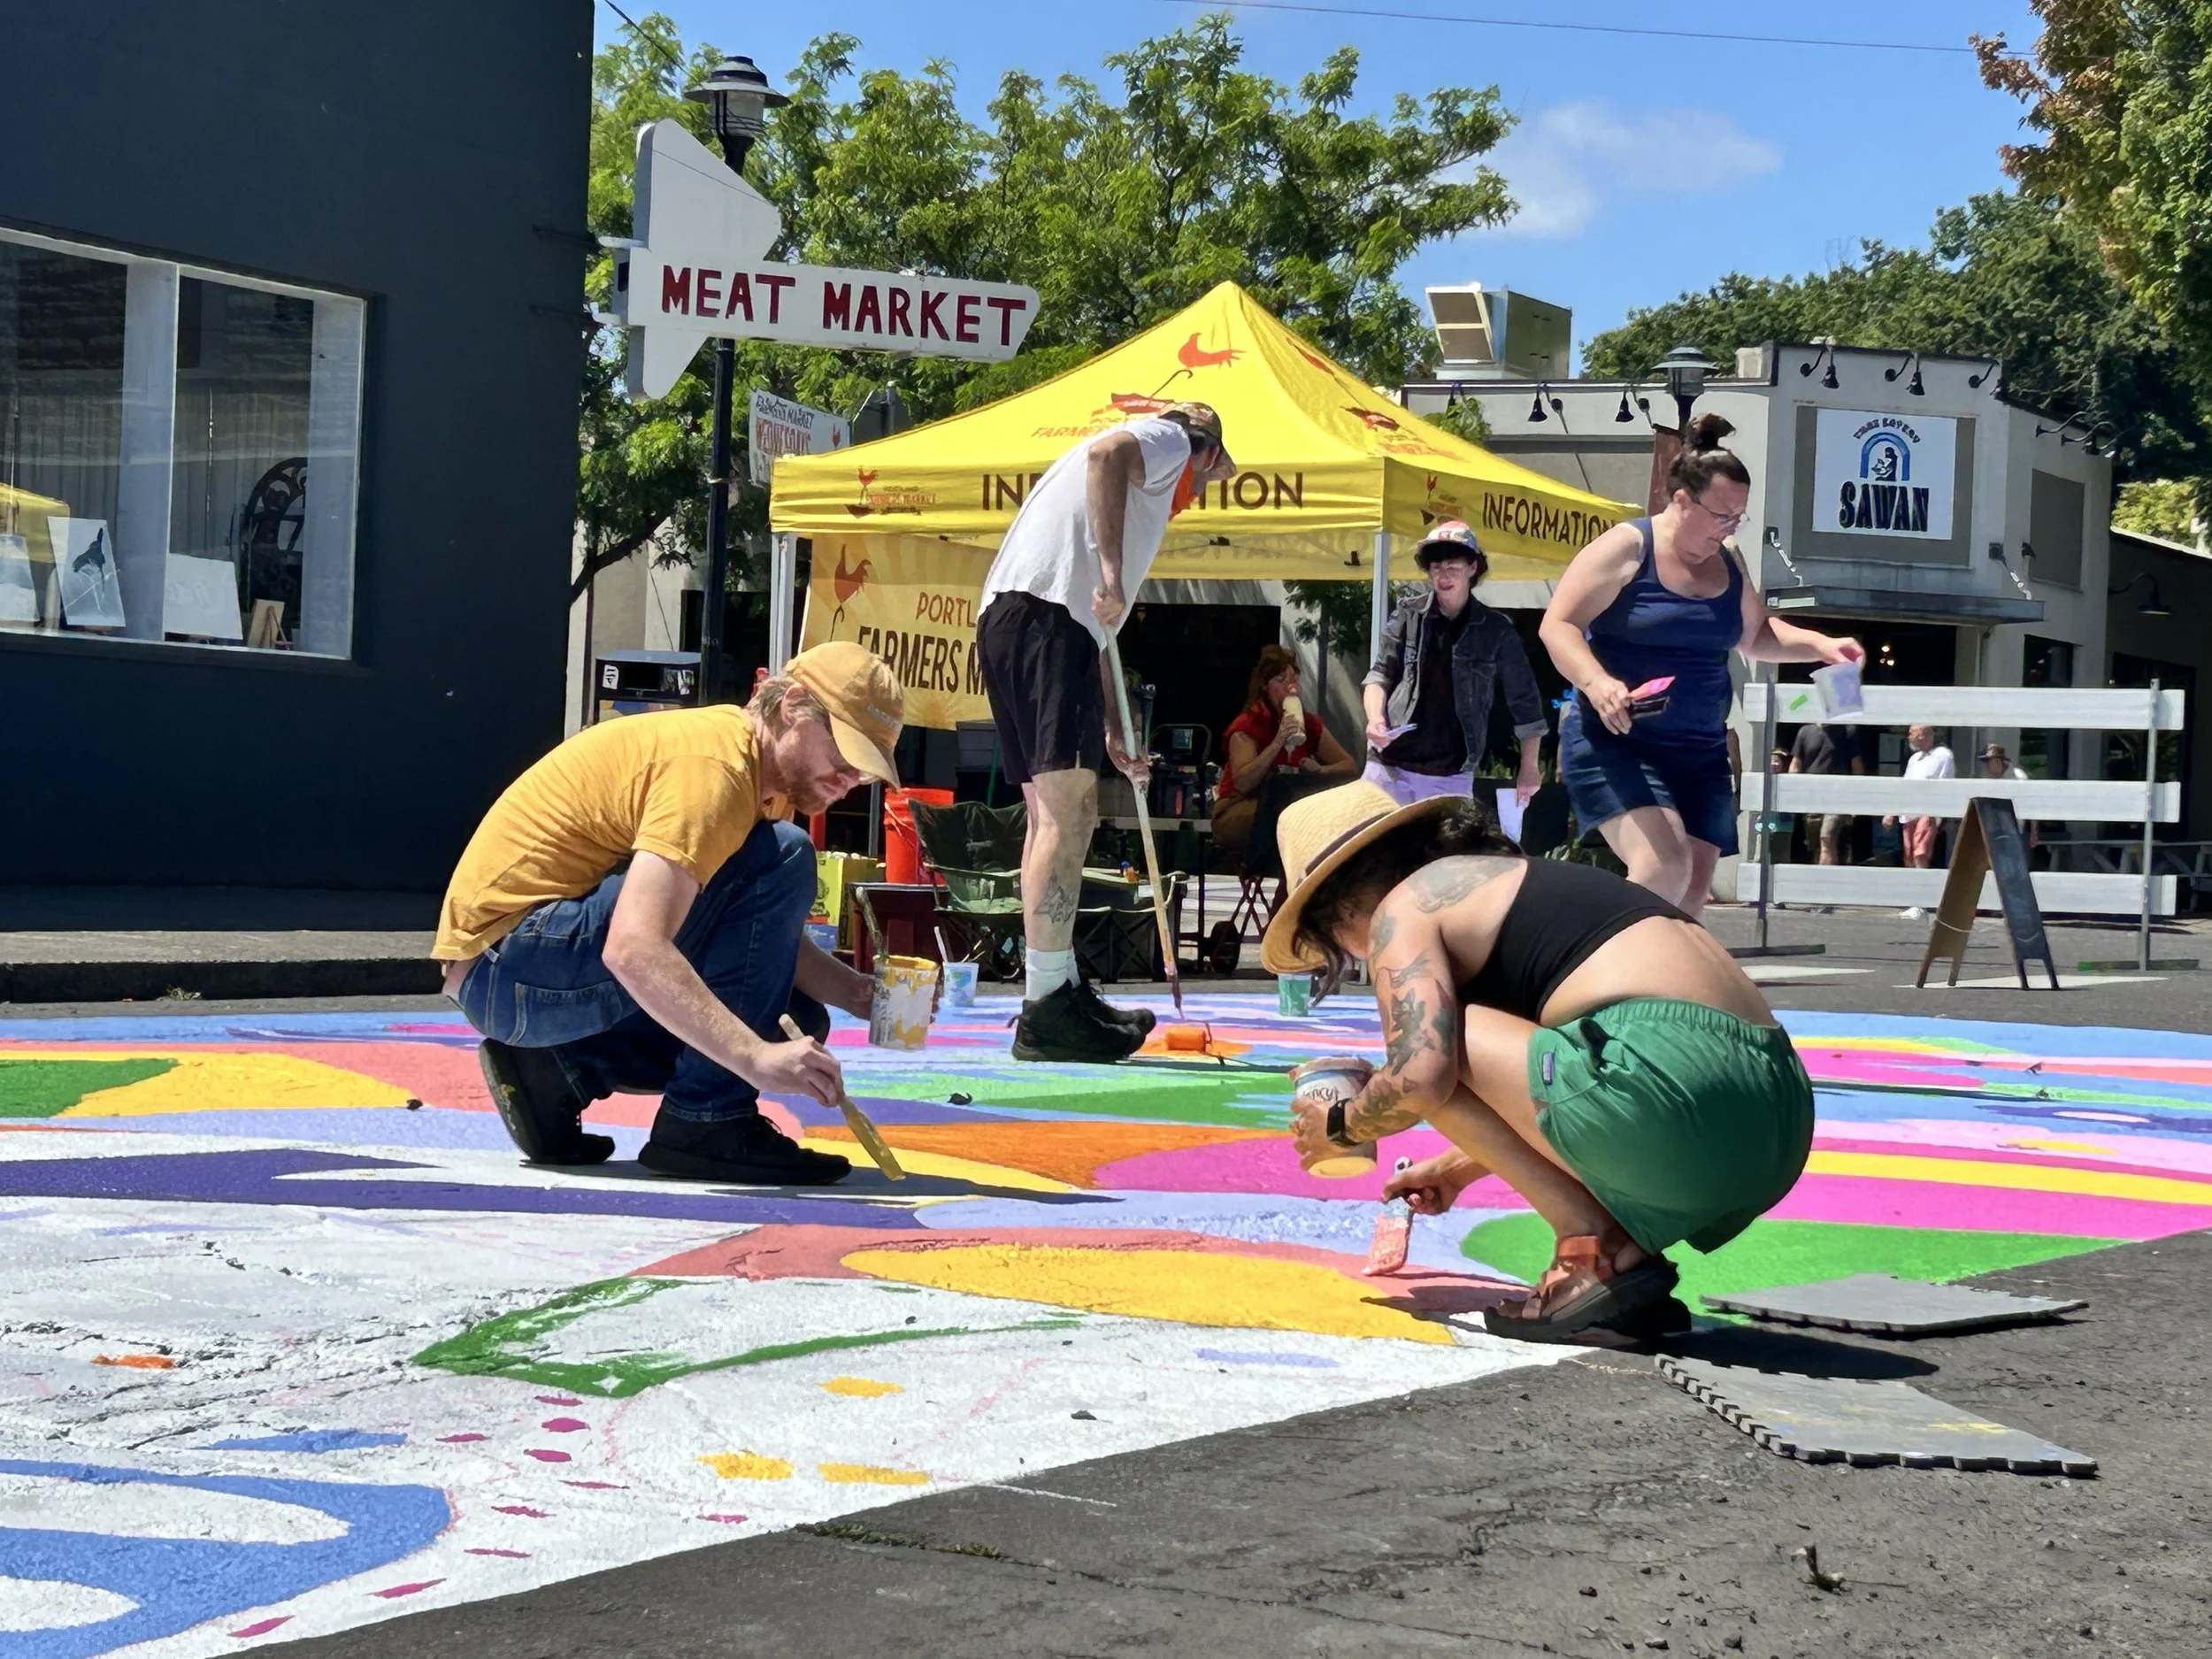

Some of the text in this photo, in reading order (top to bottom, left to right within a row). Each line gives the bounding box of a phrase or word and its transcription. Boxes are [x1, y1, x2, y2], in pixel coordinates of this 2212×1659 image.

[662, 265, 1026, 347] MEAT MARKET
[916, 591, 977, 628] PORTL
